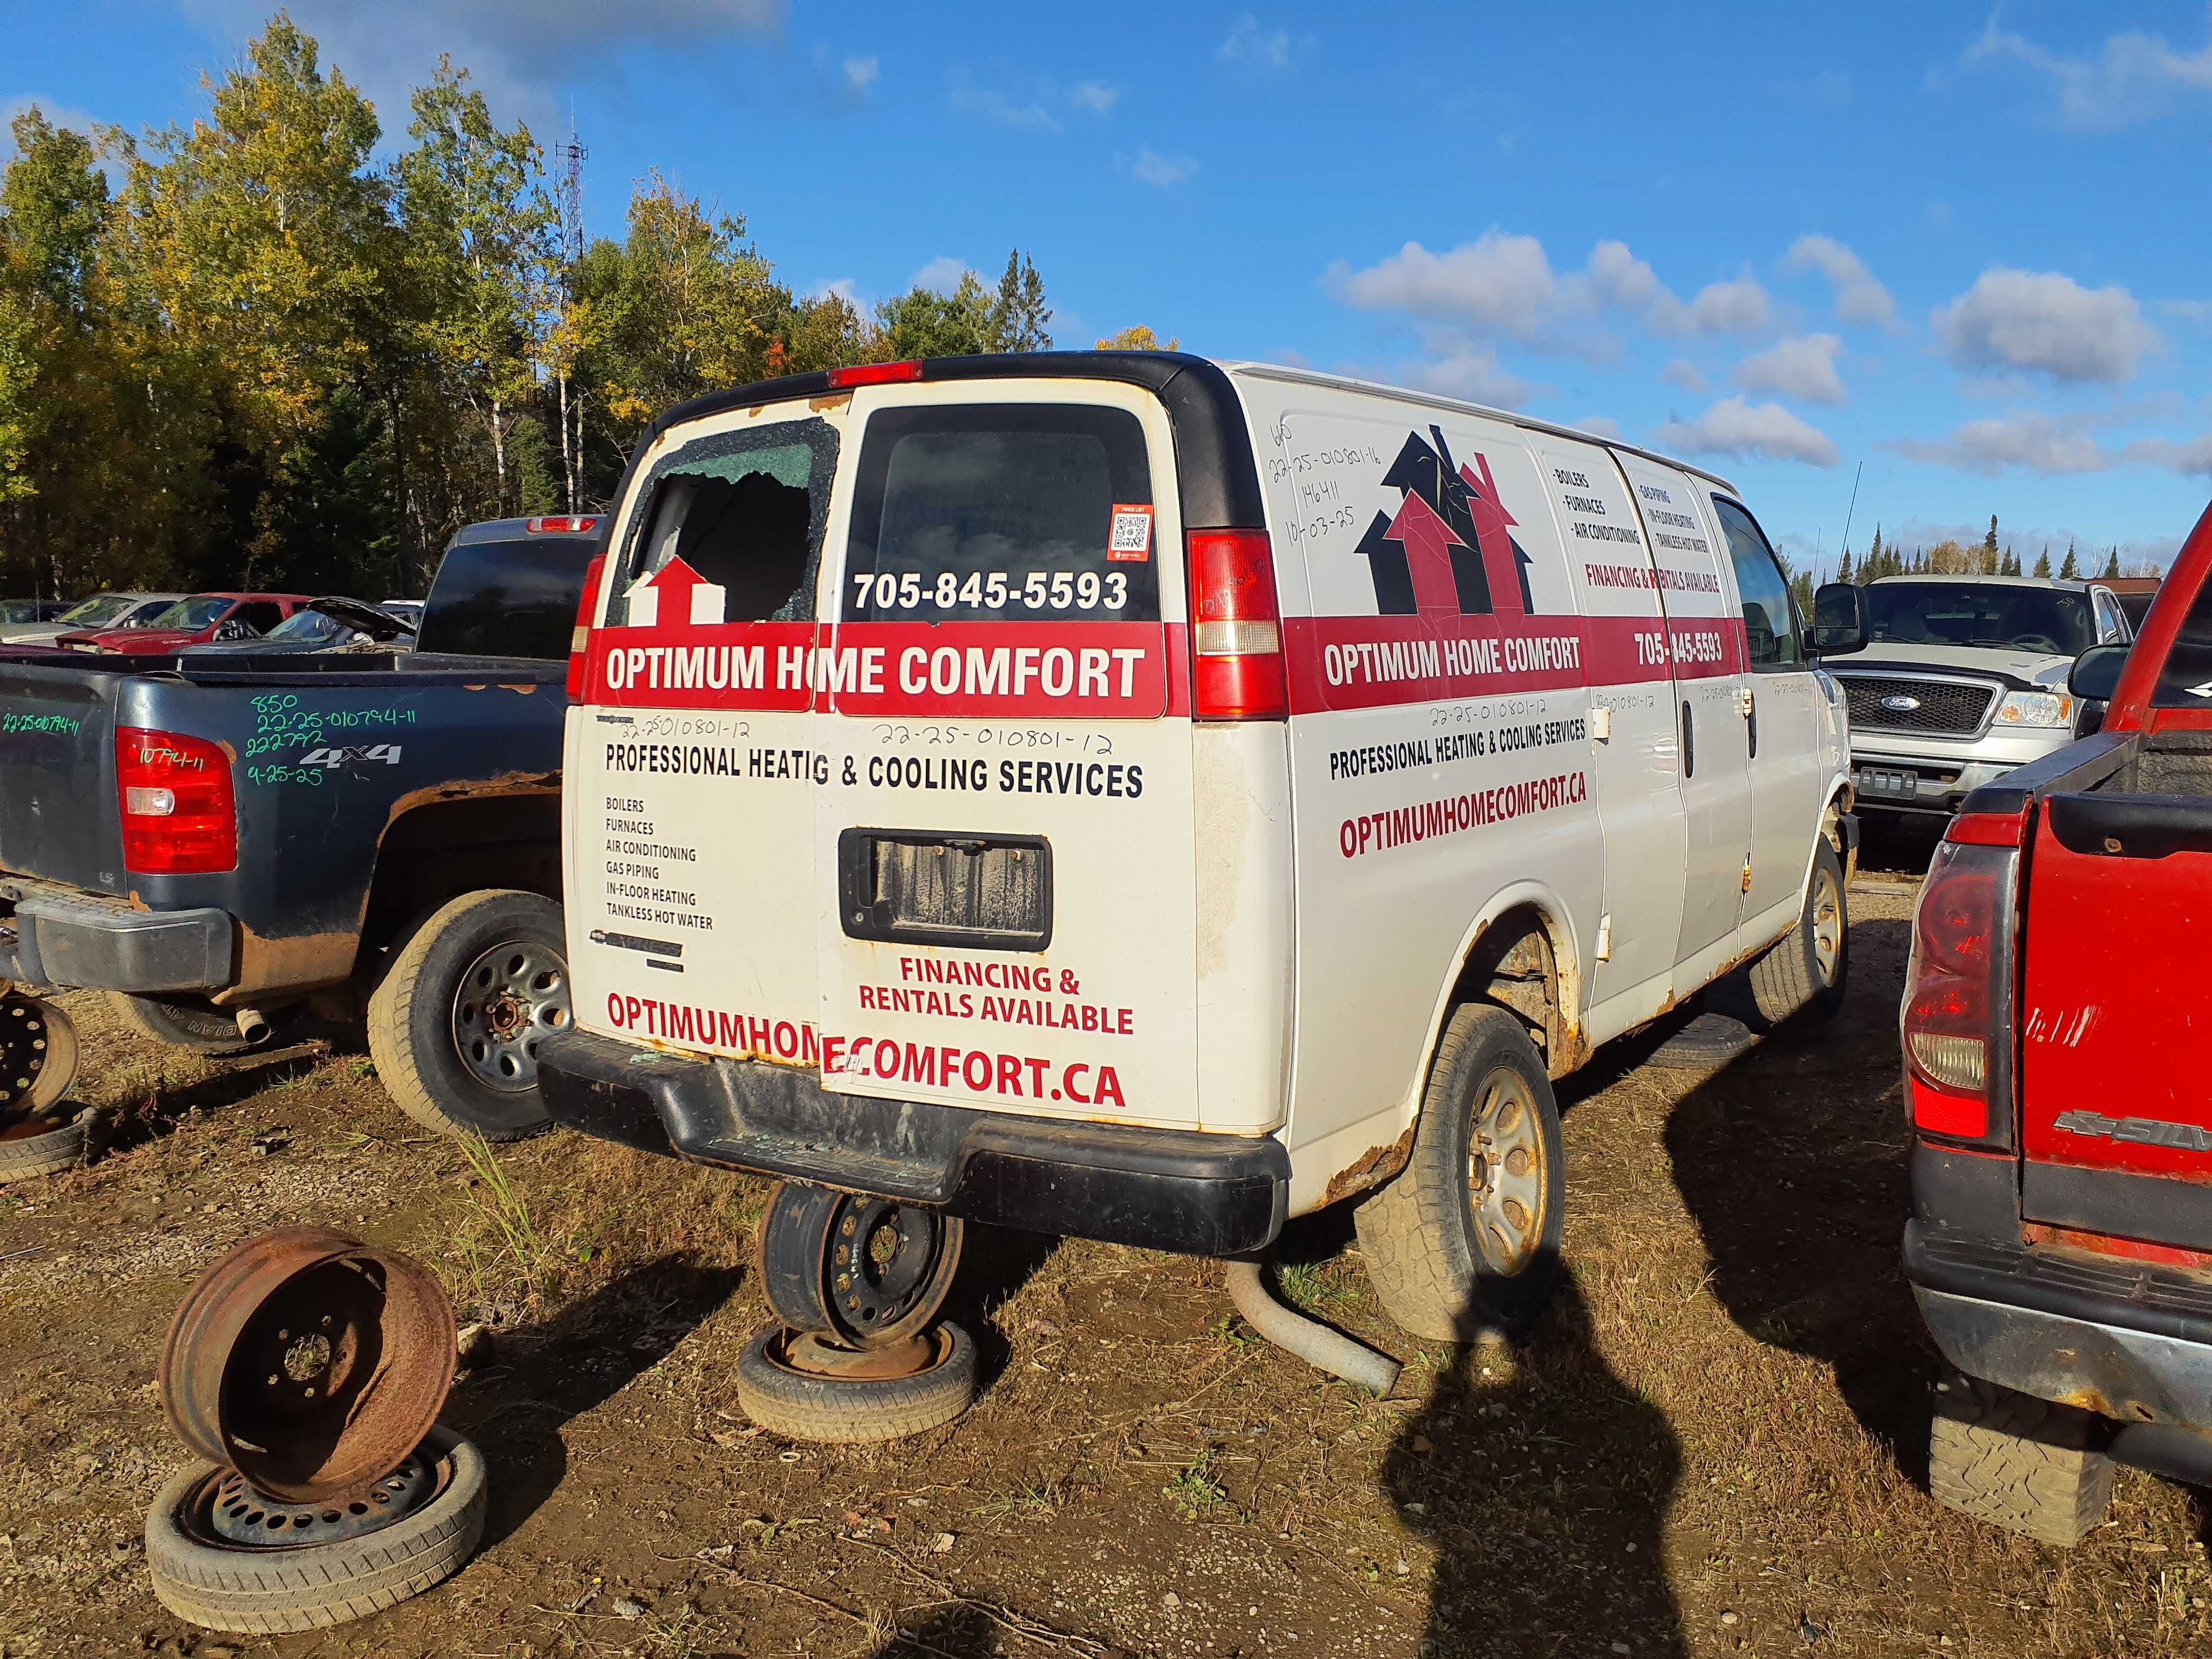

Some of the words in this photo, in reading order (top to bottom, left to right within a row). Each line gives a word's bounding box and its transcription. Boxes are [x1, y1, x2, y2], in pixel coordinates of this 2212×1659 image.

[1588, 523, 1640, 545] CONDITIONING
[1671, 513, 1695, 529] HEATING
[1680, 535, 1693, 551] HOT
[1690, 538, 1709, 554] WATER
[854, 571, 1127, 610] 705-845-5593
[1585, 564, 1641, 588] FINANCING
[1641, 568, 1650, 589] &
[1648, 568, 1685, 591] RENTALS
[1684, 571, 1720, 593] AVAILABLE
[1324, 640, 1441, 686] OPTIMUM
[1444, 638, 1503, 677] HOME
[1504, 636, 1581, 674] COMFORT
[1634, 632, 1723, 665] 705-845-5593
[607, 646, 765, 690] OPTIMUM
[776, 646, 885, 693] HOME
[899, 647, 1145, 697] COMFORT
[250, 694, 297, 713] 850
[1430, 699, 1546, 726] 22-25-010801-12
[245, 730, 327, 758] 222792
[872, 724, 1112, 755] 22-25-010801-12
[1330, 739, 1432, 780] PROFESSIONAL
[1435, 730, 1485, 763] HEATING
[1489, 736, 1497, 754] &
[1499, 723, 1542, 752] COOLING
[1544, 718, 1586, 744] SERVICES
[248, 765, 322, 786] 9-25-25
[606, 744, 741, 776] PROFESSIONAL
[842, 755, 858, 786] &
[869, 756, 988, 791] COOLING
[999, 760, 1144, 798] SERVICES
[606, 797, 644, 813] BOILERS
[1340, 771, 1587, 858] OPTIMUMHOMECOMFORT.CA
[606, 818, 654, 835] FURNACES
[606, 839, 621, 853] AIR
[623, 841, 696, 862] CONDITIONING
[606, 861, 624, 875] GAS
[626, 863, 659, 879] PIPING
[606, 881, 650, 900] IN-FLOOR
[652, 888, 696, 906] HEATING
[607, 902, 653, 922] TANKLESS
[655, 908, 676, 925] HOT
[677, 913, 713, 930] WATER
[900, 957, 1051, 992] FINANCING
[1059, 968, 1080, 995] &
[859, 985, 974, 1018] RENTALS
[981, 996, 1134, 1035] AVAILABLE
